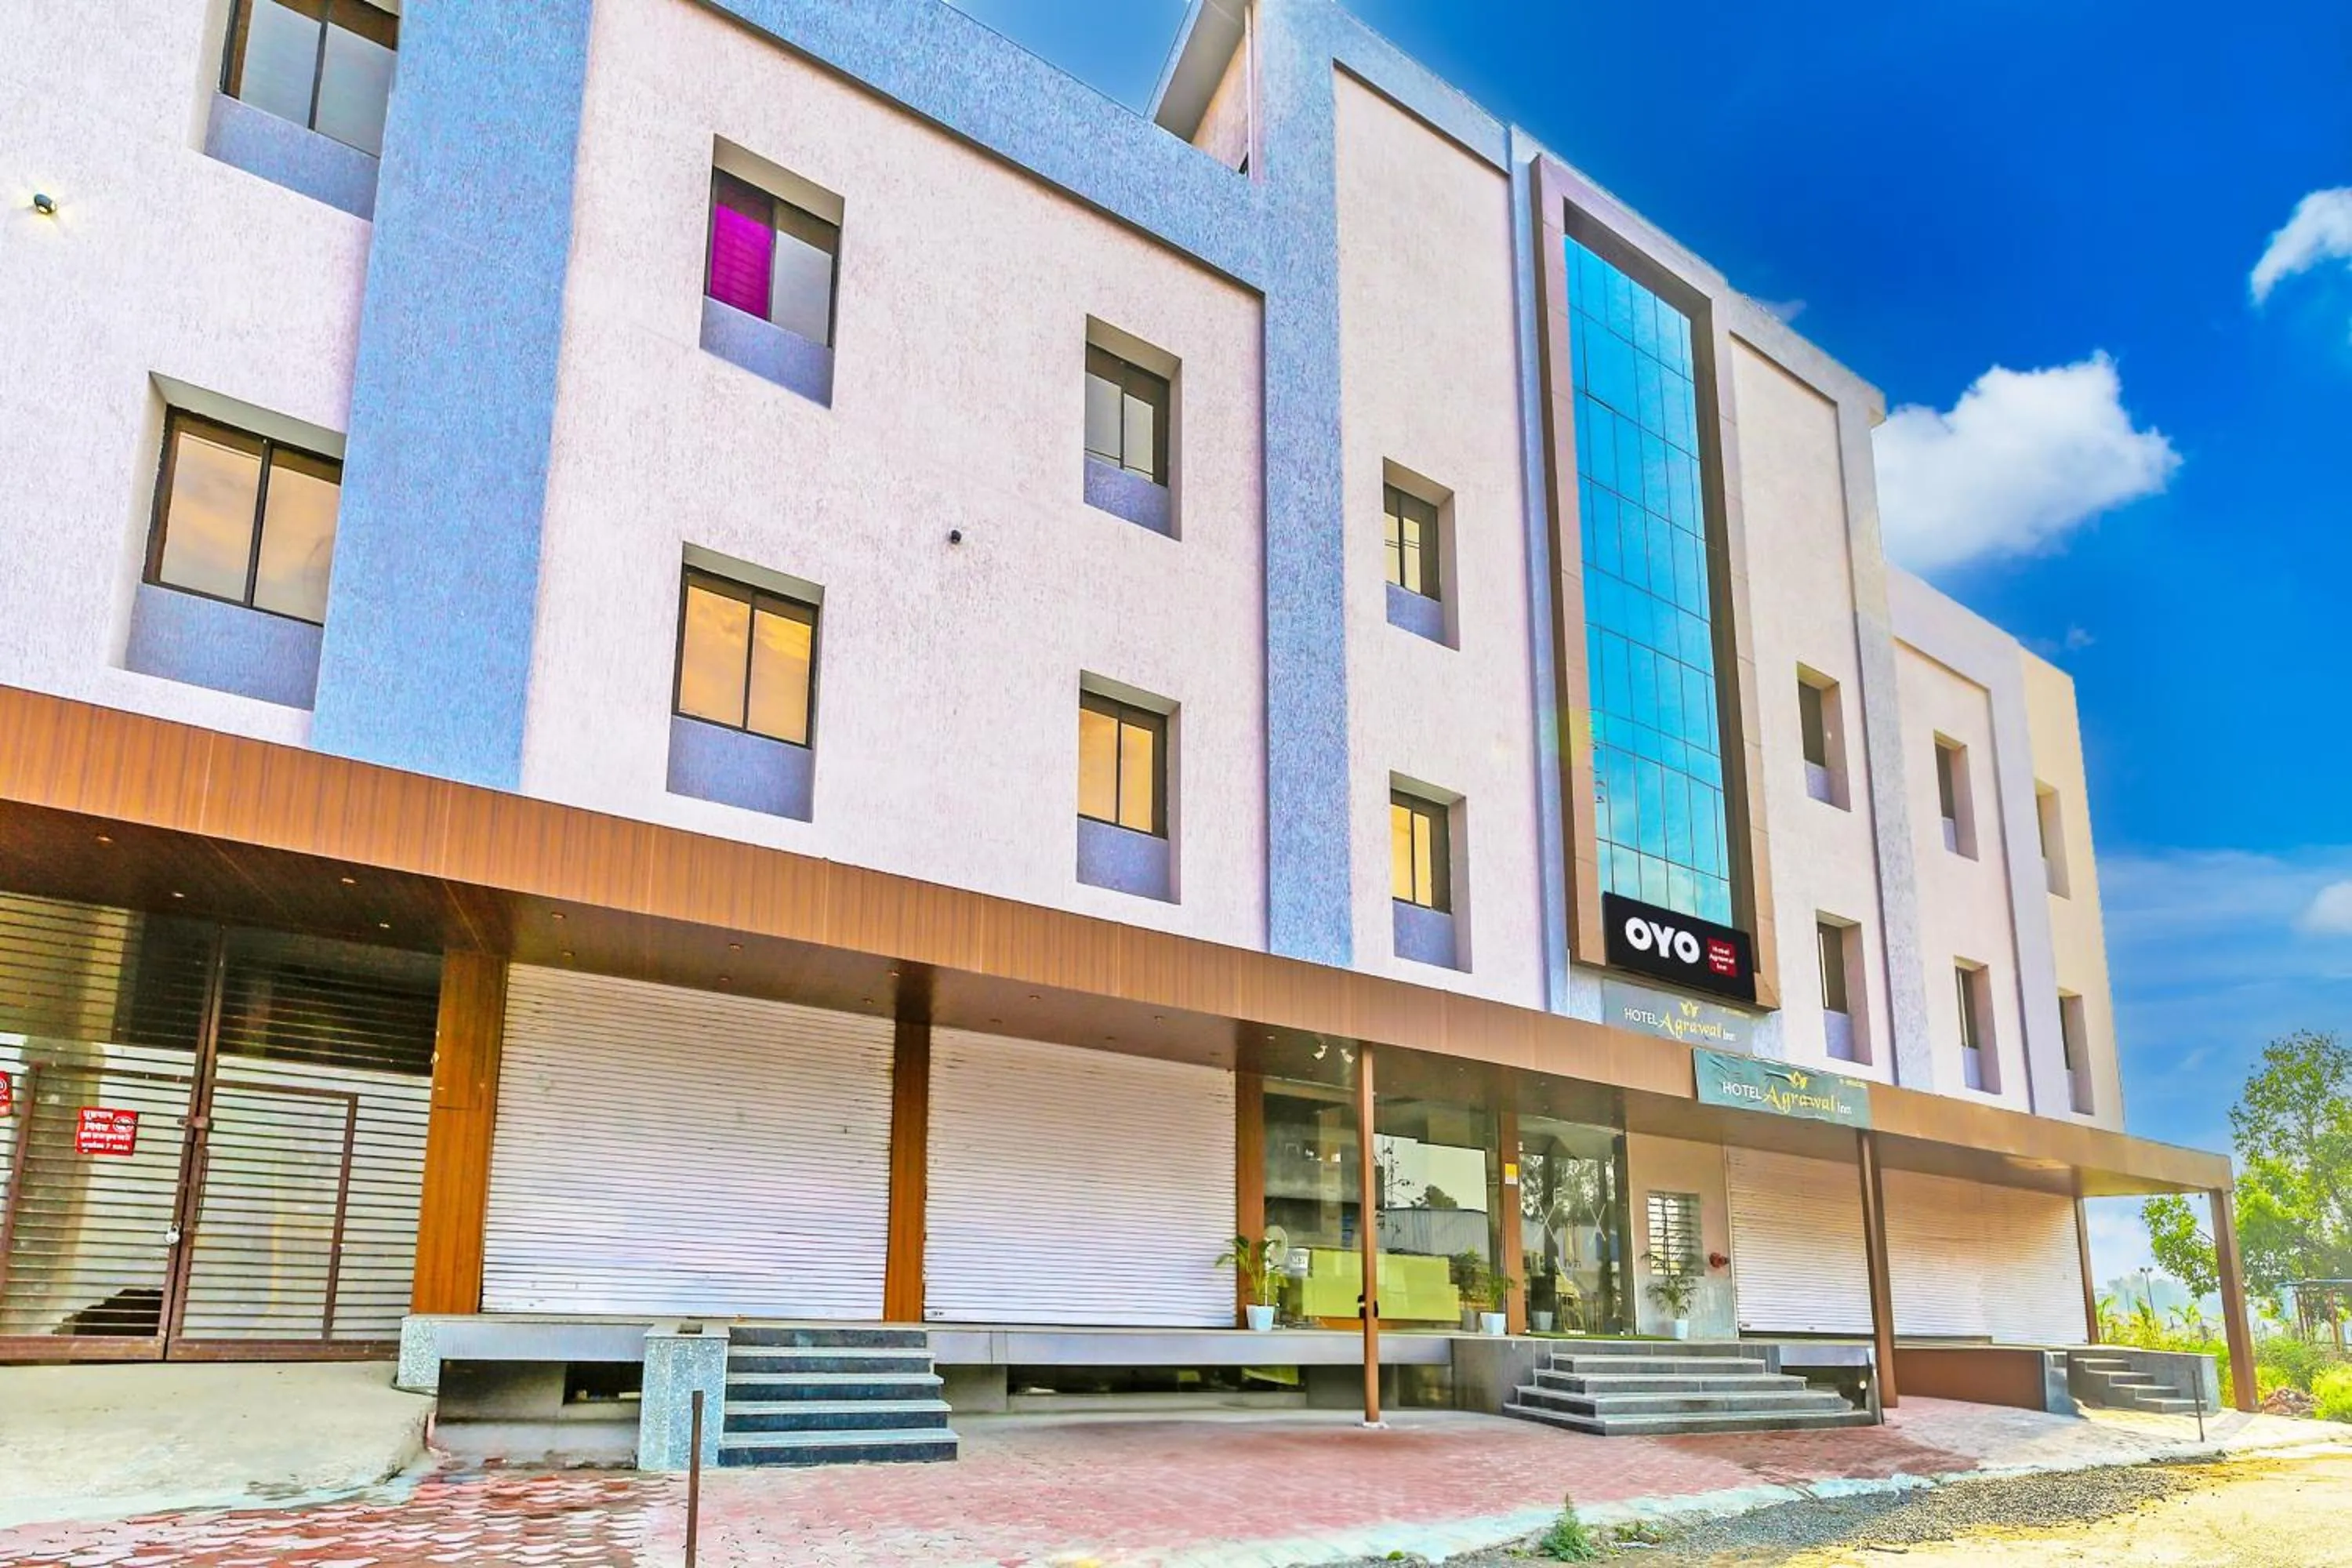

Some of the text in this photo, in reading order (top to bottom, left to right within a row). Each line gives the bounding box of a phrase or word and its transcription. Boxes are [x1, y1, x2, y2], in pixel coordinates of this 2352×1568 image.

[1624, 916, 1700, 964] OYO
[1624, 1007, 1657, 1025] HOTEL
[1657, 1011, 1722, 1040] Agrawal
[1722, 1081, 1762, 1100] HOTEL
[1762, 1084, 1835, 1116] Agrawal
